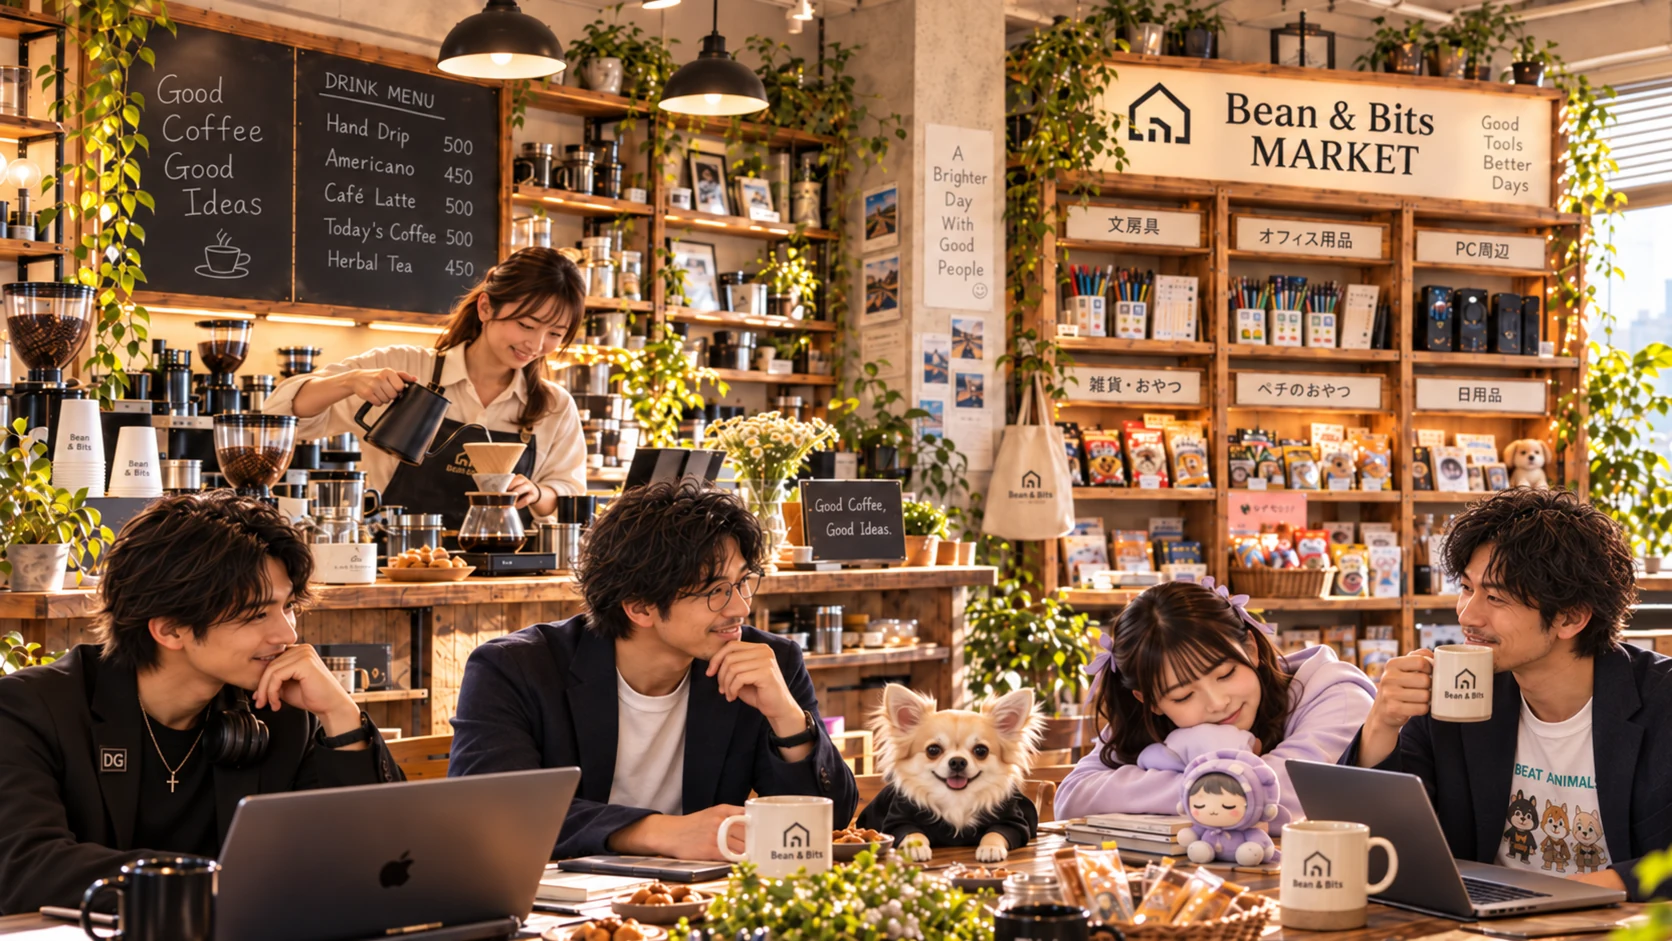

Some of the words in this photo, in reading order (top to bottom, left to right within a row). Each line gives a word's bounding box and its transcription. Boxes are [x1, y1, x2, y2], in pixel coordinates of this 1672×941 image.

[157, 74, 223, 104] Good
[325, 72, 378, 97] DRINK
[388, 85, 435, 108] MENU
[1225, 92, 1318, 129] Bean
[1329, 100, 1356, 131] &
[1368, 101, 1434, 136] Bits
[1481, 115, 1519, 131] Good
[162, 113, 263, 142] Coffee
[327, 112, 368, 137] Hand
[378, 122, 410, 149] Drip
[443, 136, 473, 155] 500
[1483, 135, 1523, 151] Tools
[952, 145, 964, 161] A
[1250, 135, 1420, 175] MARKET
[164, 152, 234, 180] Good
[325, 148, 415, 176] Americano
[444, 166, 473, 185] 450
[1483, 154, 1532, 171] Better
[933, 166, 988, 188] Brighter
[1492, 175, 1529, 196] Days
[182, 187, 262, 216] Ideas
[324, 182, 364, 204] Café
[375, 187, 416, 208] Latte
[445, 197, 473, 216] 500
[944, 191, 973, 213] Day
[324, 217, 383, 244] Today's
[390, 223, 436, 244] Coffee
[446, 229, 473, 247] 500
[942, 215, 974, 231] With
[1107, 215, 1160, 235] 文房具
[939, 237, 974, 252] Good
[1259, 227, 1353, 249] オフィス用品
[1456, 241, 1510, 260] PC周辺
[328, 249, 378, 271] Herbal
[387, 255, 413, 273] Tea
[445, 259, 474, 277] 450
[938, 259, 984, 281] People
[1089, 376, 1182, 394] 雑貨・おやつ
[1258, 382, 1351, 398] ペチのおやつ
[1459, 386, 1502, 403] 日用品
[70, 433, 90, 441] Bean
[67, 443, 74, 451] &
[76, 443, 92, 451] Bits
[124, 469, 131, 477] &
[134, 469, 150, 477] Bits
[128, 460, 149, 468] Bean
[1008, 490, 1028, 499] Bean
[1029, 491, 1035, 499] &
[1037, 491, 1053, 499] Bits
[815, 497, 843, 512] Good
[848, 496, 886, 513] Coffee,
[826, 521, 854, 537] Good
[860, 521, 892, 535] Ideas.
[1444, 691, 1463, 699] Bean
[1464, 692, 1470, 700] &
[1471, 692, 1484, 700] Bits
[103, 753, 124, 767] DG
[1514, 763, 1544, 781] BEAT
[1546, 771, 1598, 789] ANIMAL
[770, 850, 794, 860] Bean
[796, 851, 803, 860] &
[806, 850, 823, 860] Bits
[1292, 879, 1314, 888] Bean
[1316, 880, 1323, 889] &
[1325, 880, 1343, 889] Bits
